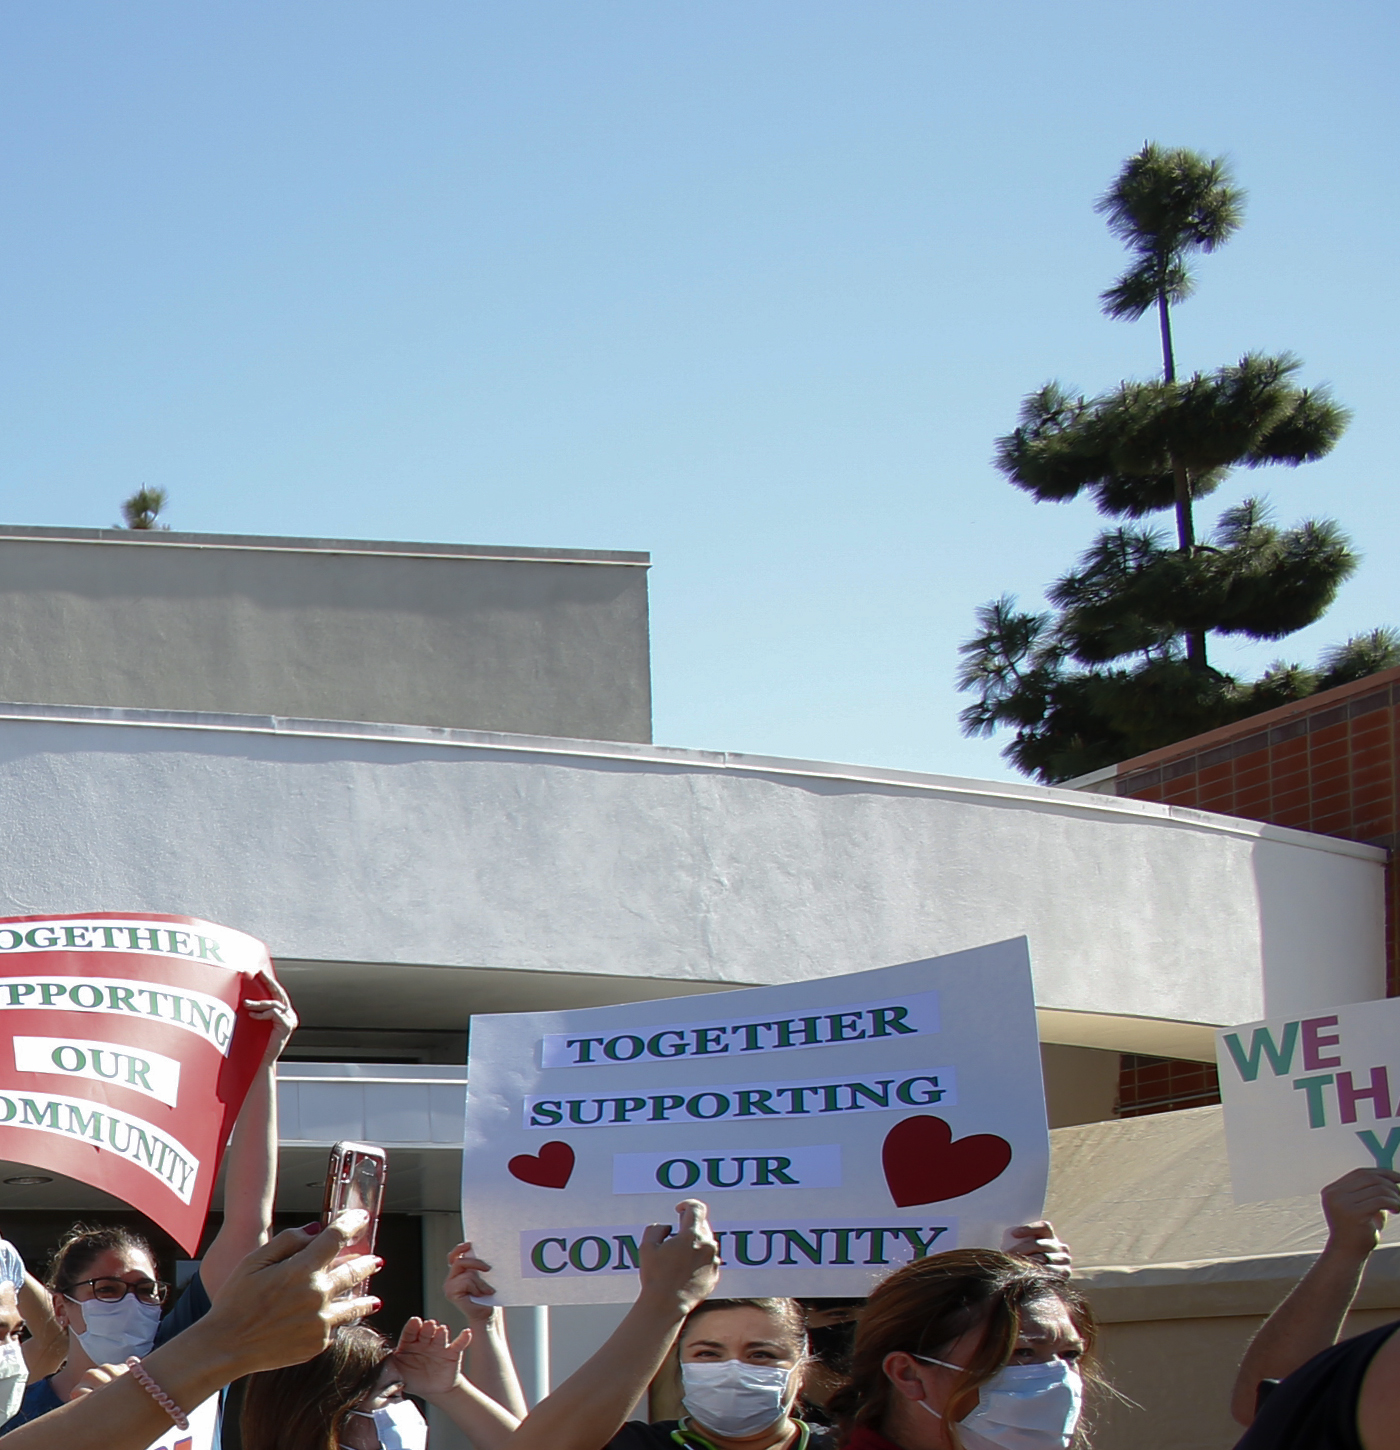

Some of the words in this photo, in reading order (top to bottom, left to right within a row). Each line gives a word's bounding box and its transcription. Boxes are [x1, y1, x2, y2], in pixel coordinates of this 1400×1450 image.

[566, 1005, 918, 1064] TOGETHER
[1222, 1015, 1341, 1082] WE
[51, 1045, 155, 1091] OUR
[530, 1075, 947, 1127] SUPPORTING
[1293, 1065, 1400, 1129] TH
[656, 1156, 800, 1190] OUR
[530, 1226, 948, 1273] COMUNITY
